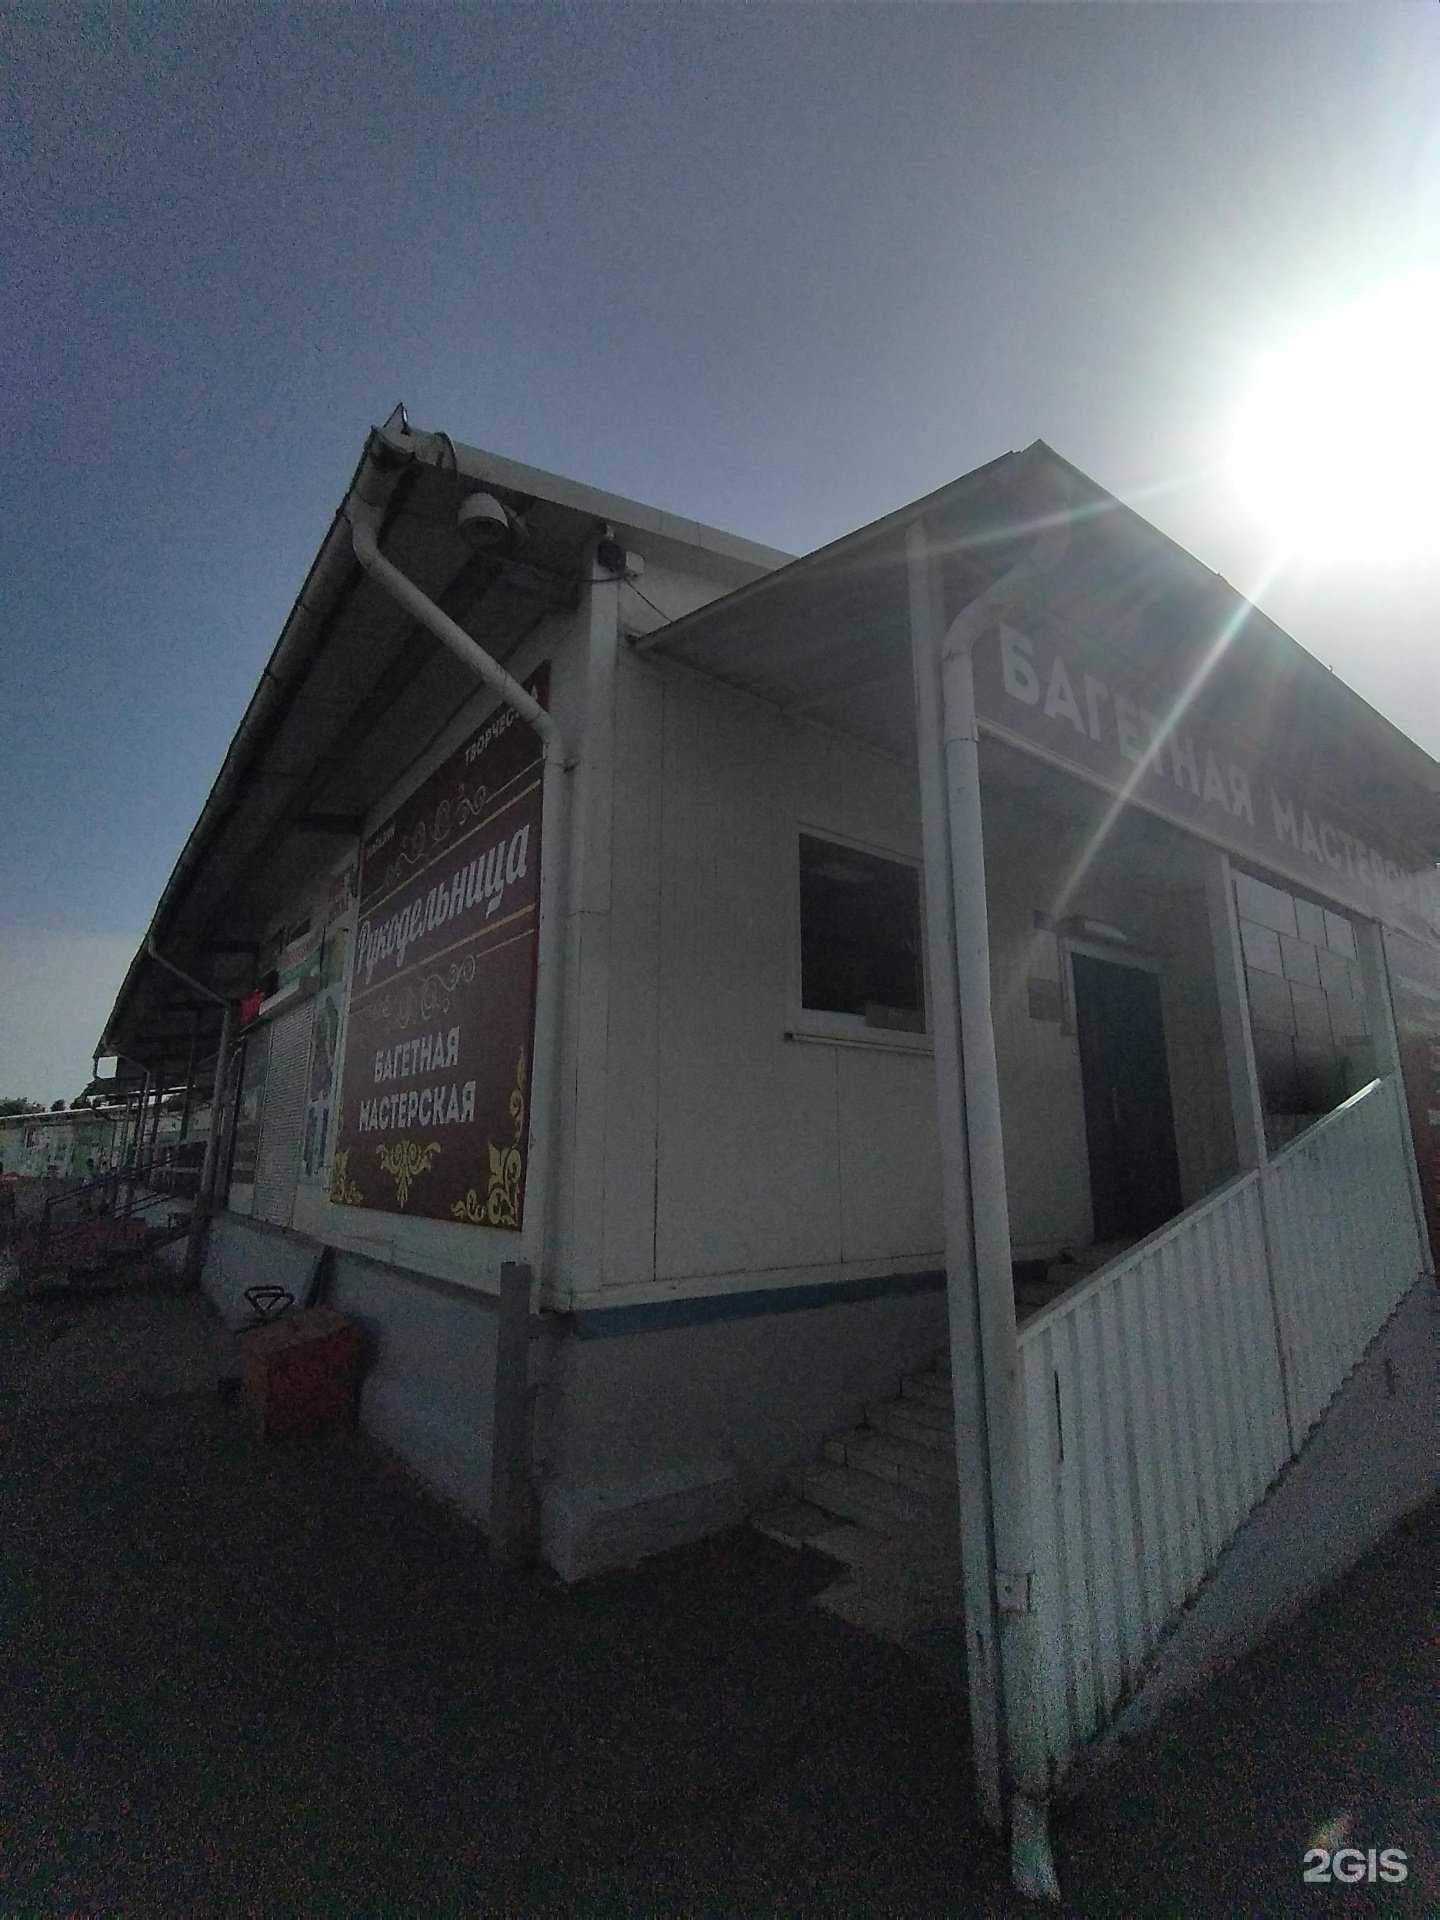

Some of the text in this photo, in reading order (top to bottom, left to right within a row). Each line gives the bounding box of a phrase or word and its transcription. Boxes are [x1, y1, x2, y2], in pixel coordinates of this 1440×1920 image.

[998, 622, 1254, 827] БАГЕТНАЯ
[357, 823, 530, 985] Рукодельница
[358, 1079, 477, 1132] МАСТЕРСКАЯ
[374, 1023, 462, 1083] БАГЕТНАЯ
